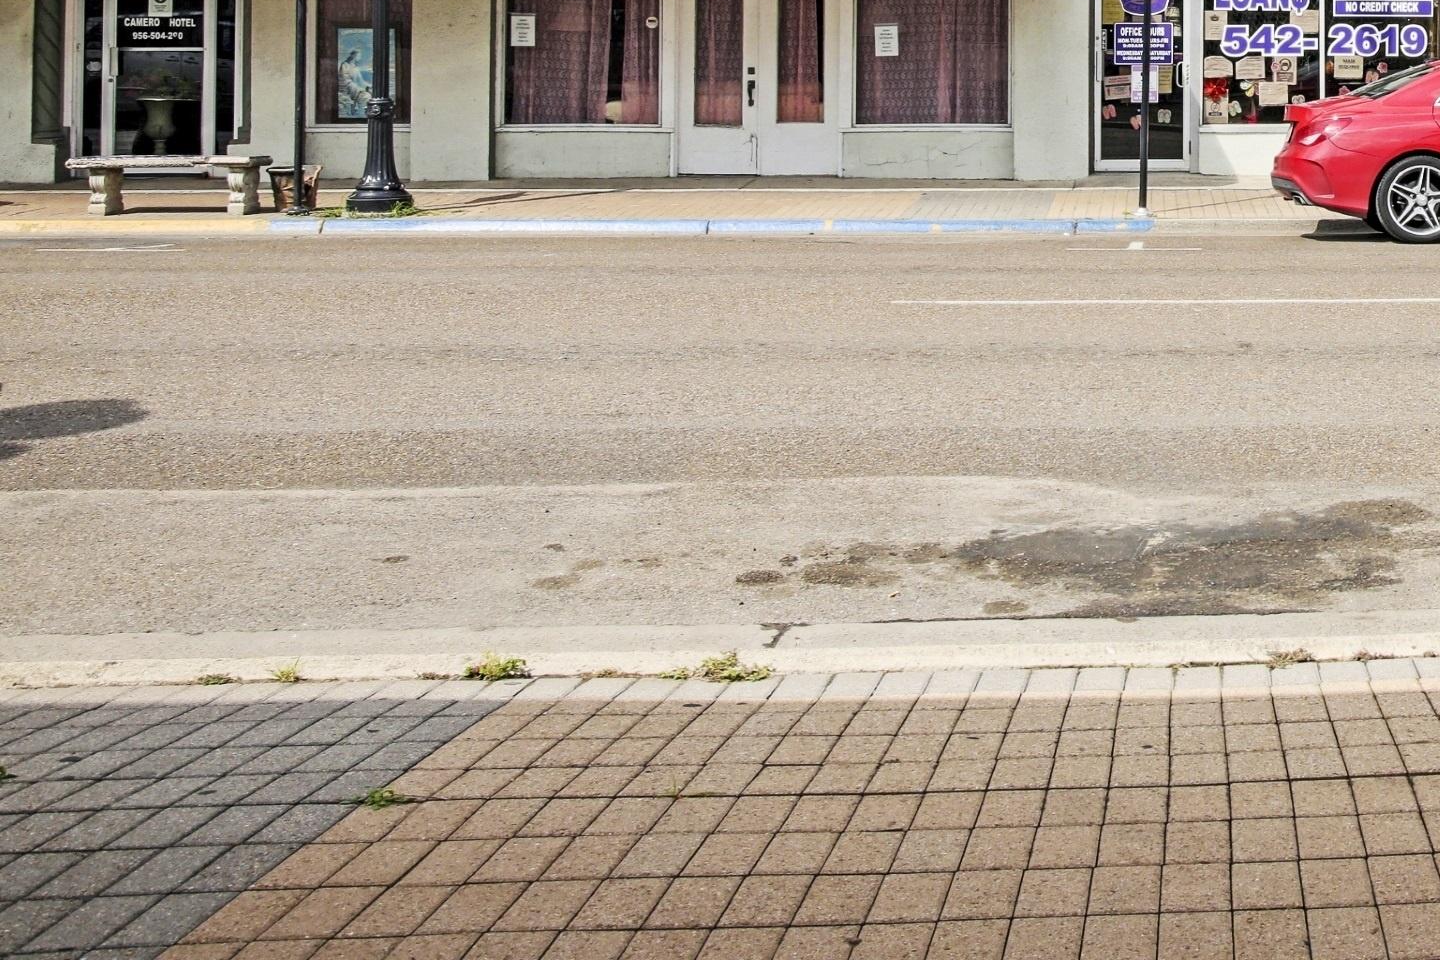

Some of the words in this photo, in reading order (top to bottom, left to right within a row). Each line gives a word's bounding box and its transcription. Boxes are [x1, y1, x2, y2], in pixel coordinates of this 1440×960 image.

[1345, 1, 1356, 12] NO
[1360, 1, 1388, 12] CREDIT
[1390, 1, 1419, 12] CHECK
[124, 18, 160, 27] CAMERO
[169, 18, 196, 27] HOTEL
[1120, 27, 1142, 36] OFFICE
[1220, 24, 1318, 57] 542-
[1327, 23, 1428, 57] 2619
